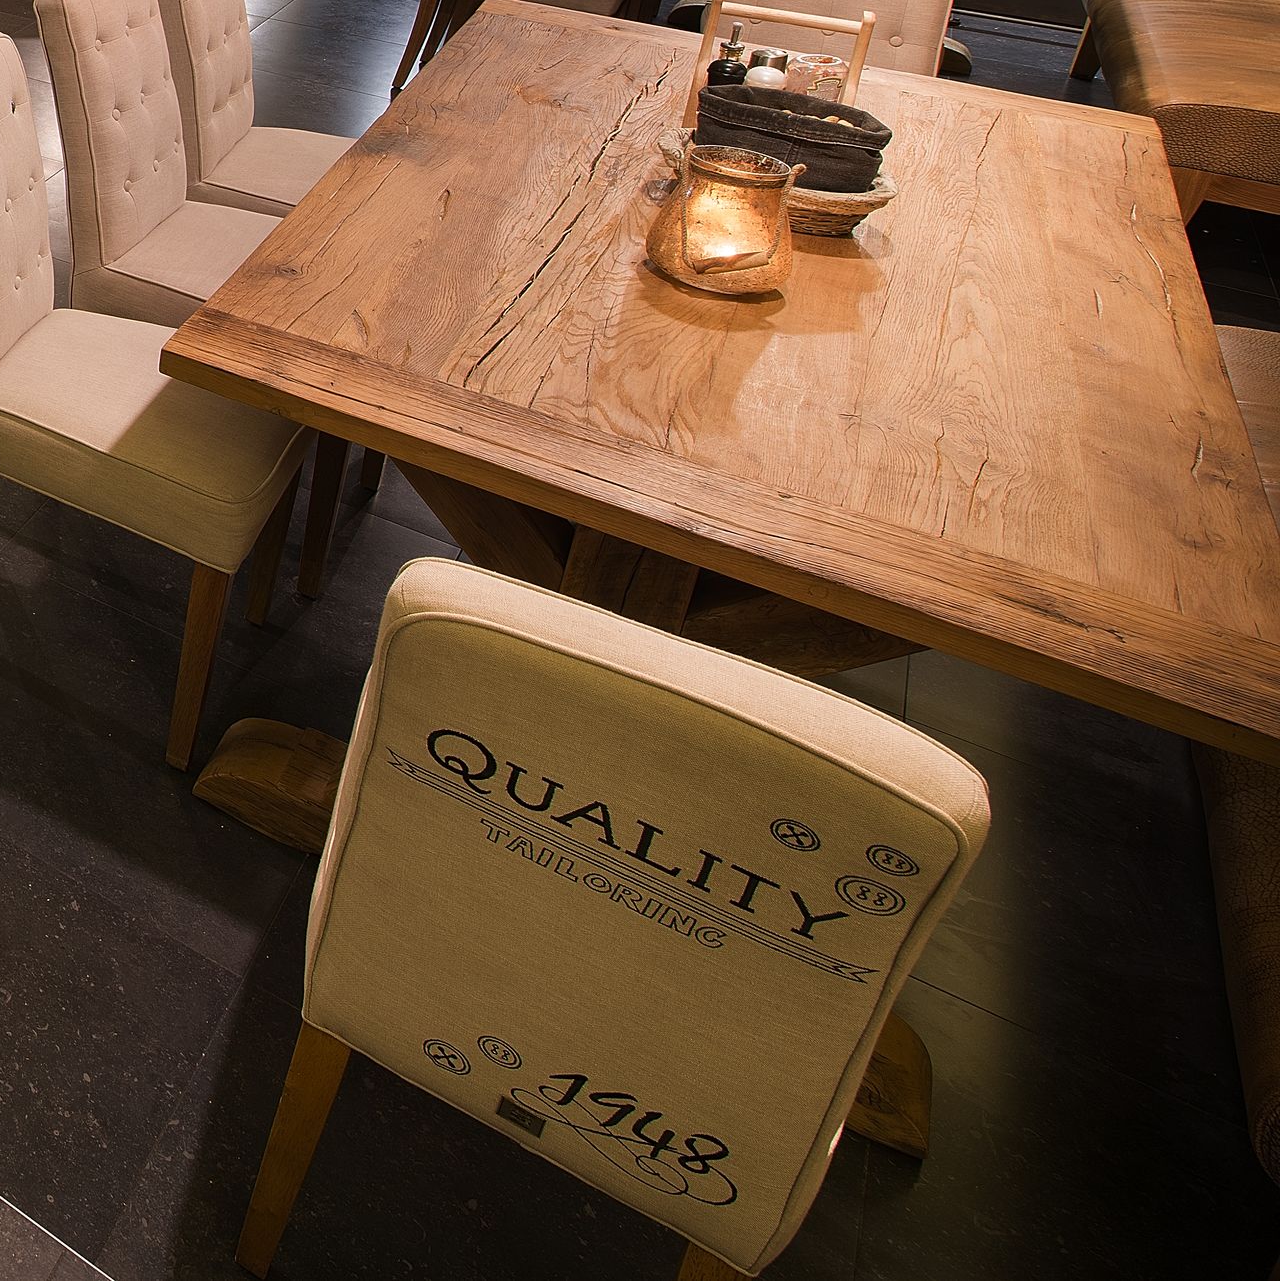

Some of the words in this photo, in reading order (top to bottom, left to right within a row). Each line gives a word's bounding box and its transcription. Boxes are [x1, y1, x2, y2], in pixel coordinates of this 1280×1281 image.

[425, 727, 851, 942] QUALITY
[480, 818, 726, 950] TAILORING
[545, 1072, 732, 1177] 1948
